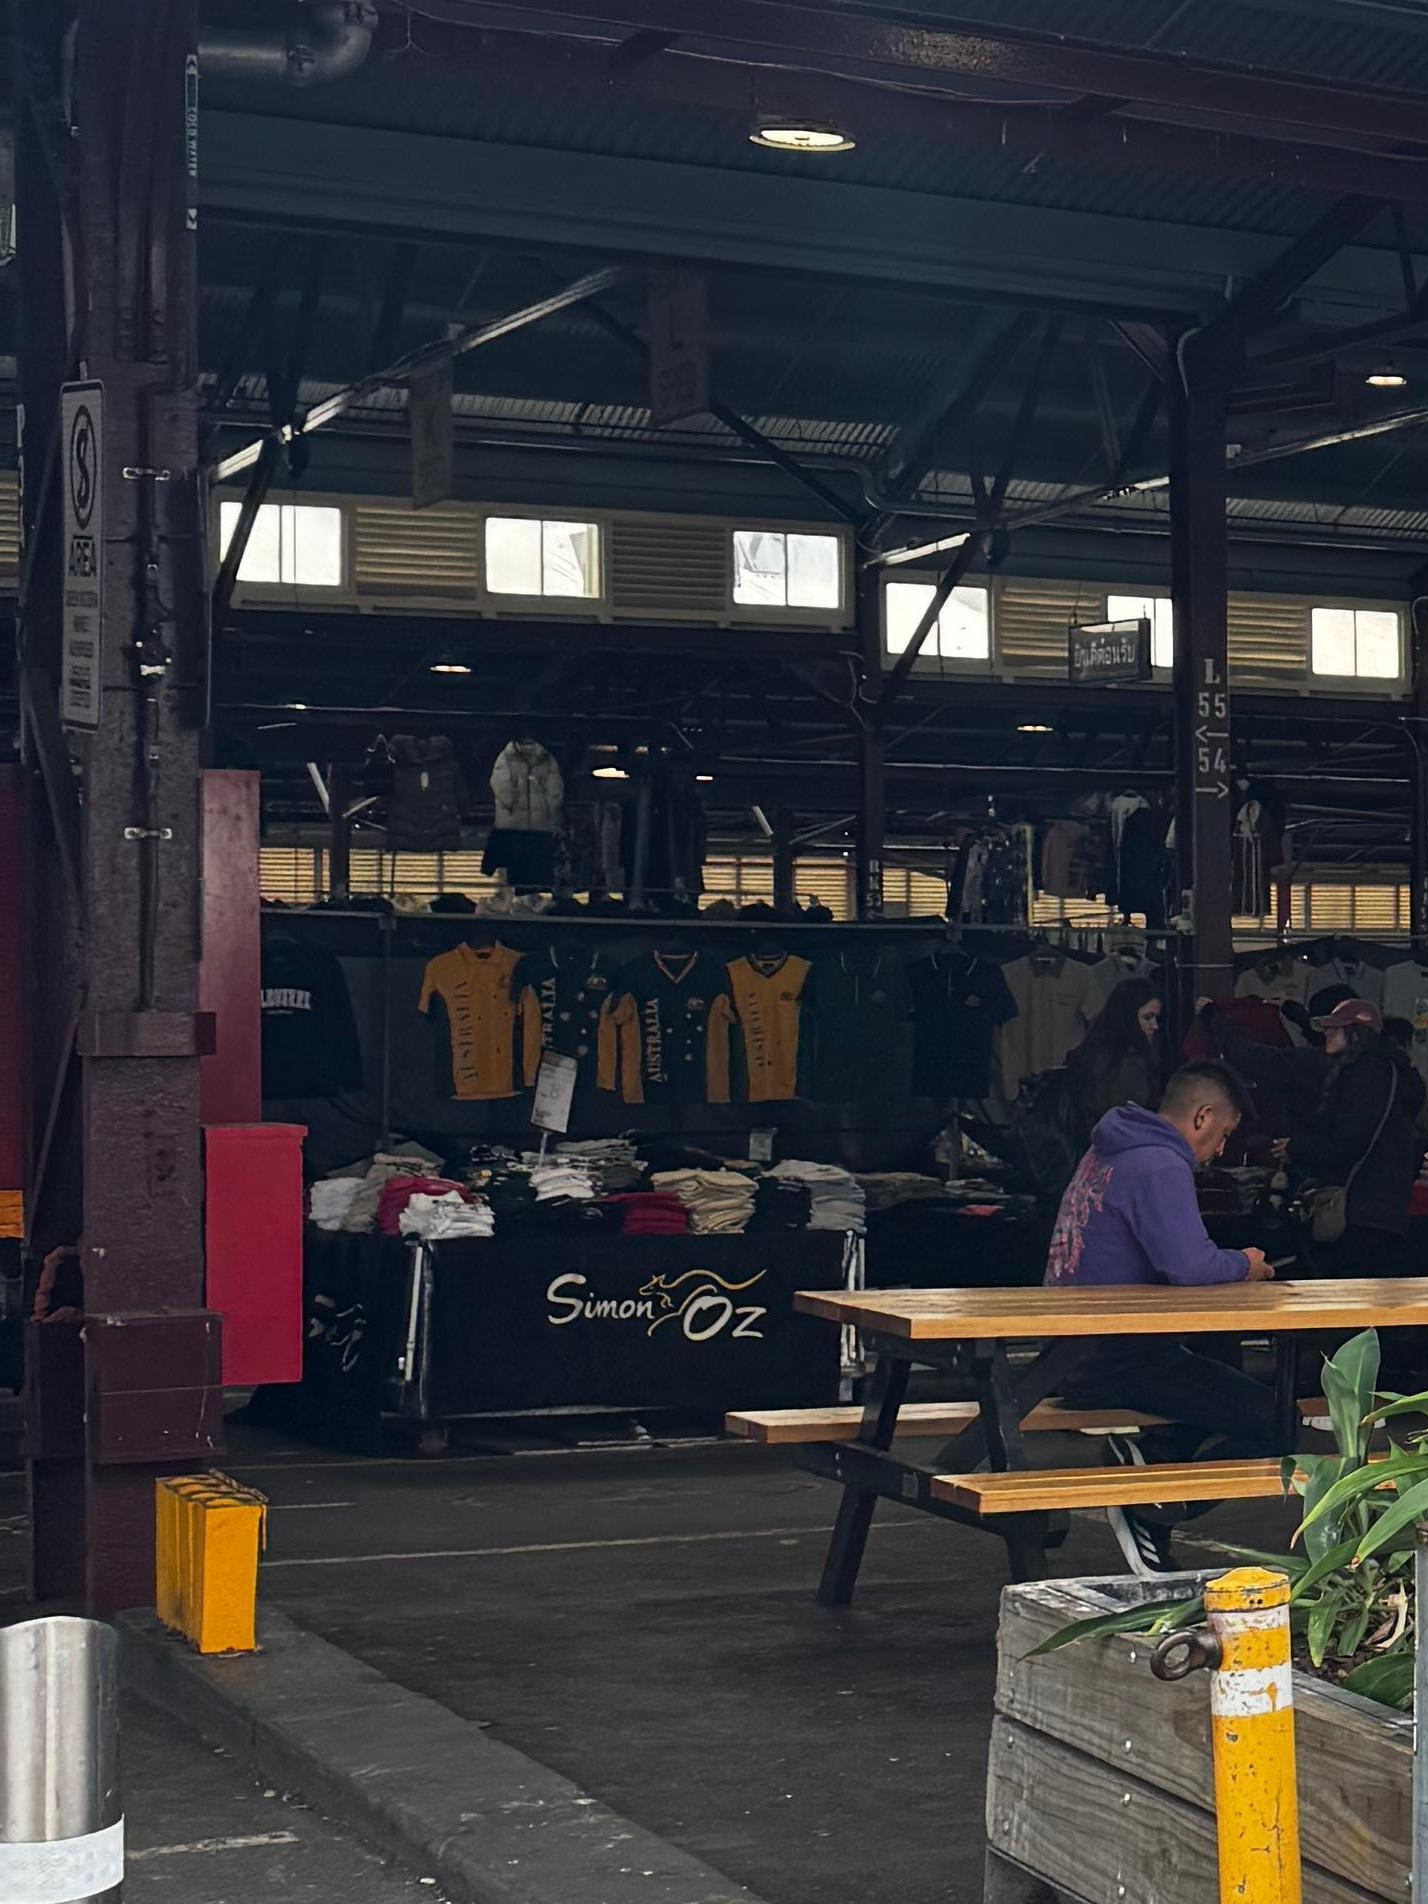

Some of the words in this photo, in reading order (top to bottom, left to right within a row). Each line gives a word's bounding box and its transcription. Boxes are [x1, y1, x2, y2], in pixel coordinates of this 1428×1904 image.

[1204, 658, 1220, 684] L
[1198, 692, 1226, 718] 55
[1198, 748, 1226, 773] 54
[546, 1272, 656, 1325] Simon
[682, 1295, 768, 1342] Oz
